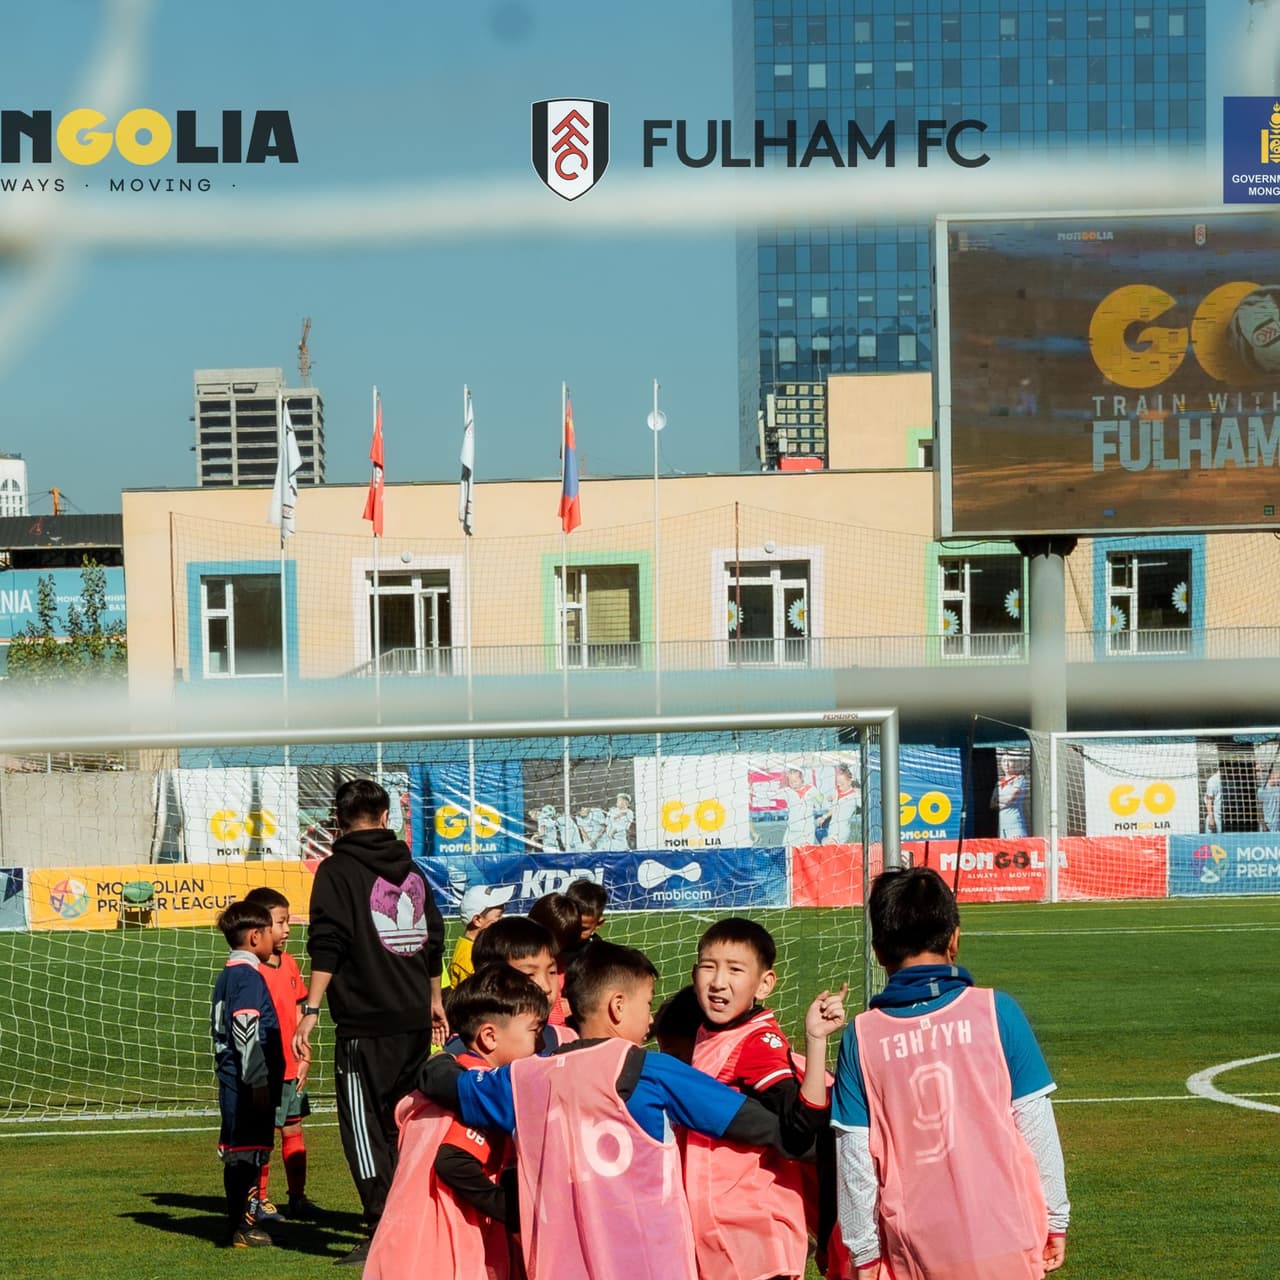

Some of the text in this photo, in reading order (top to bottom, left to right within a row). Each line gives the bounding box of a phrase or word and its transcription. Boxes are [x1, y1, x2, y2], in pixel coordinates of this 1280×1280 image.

[1092, 394, 1186, 415] TRAIN
[661, 798, 727, 833] GO
[1109, 782, 1177, 816] GO
[210, 809, 278, 842] GO
[434, 803, 502, 839] GO
[940, 851, 1069, 872] MONGOLA
[97, 879, 205, 895] MOOLIAN
[653, 888, 712, 901] mobicom
[909, 1061, 956, 1165] 9
